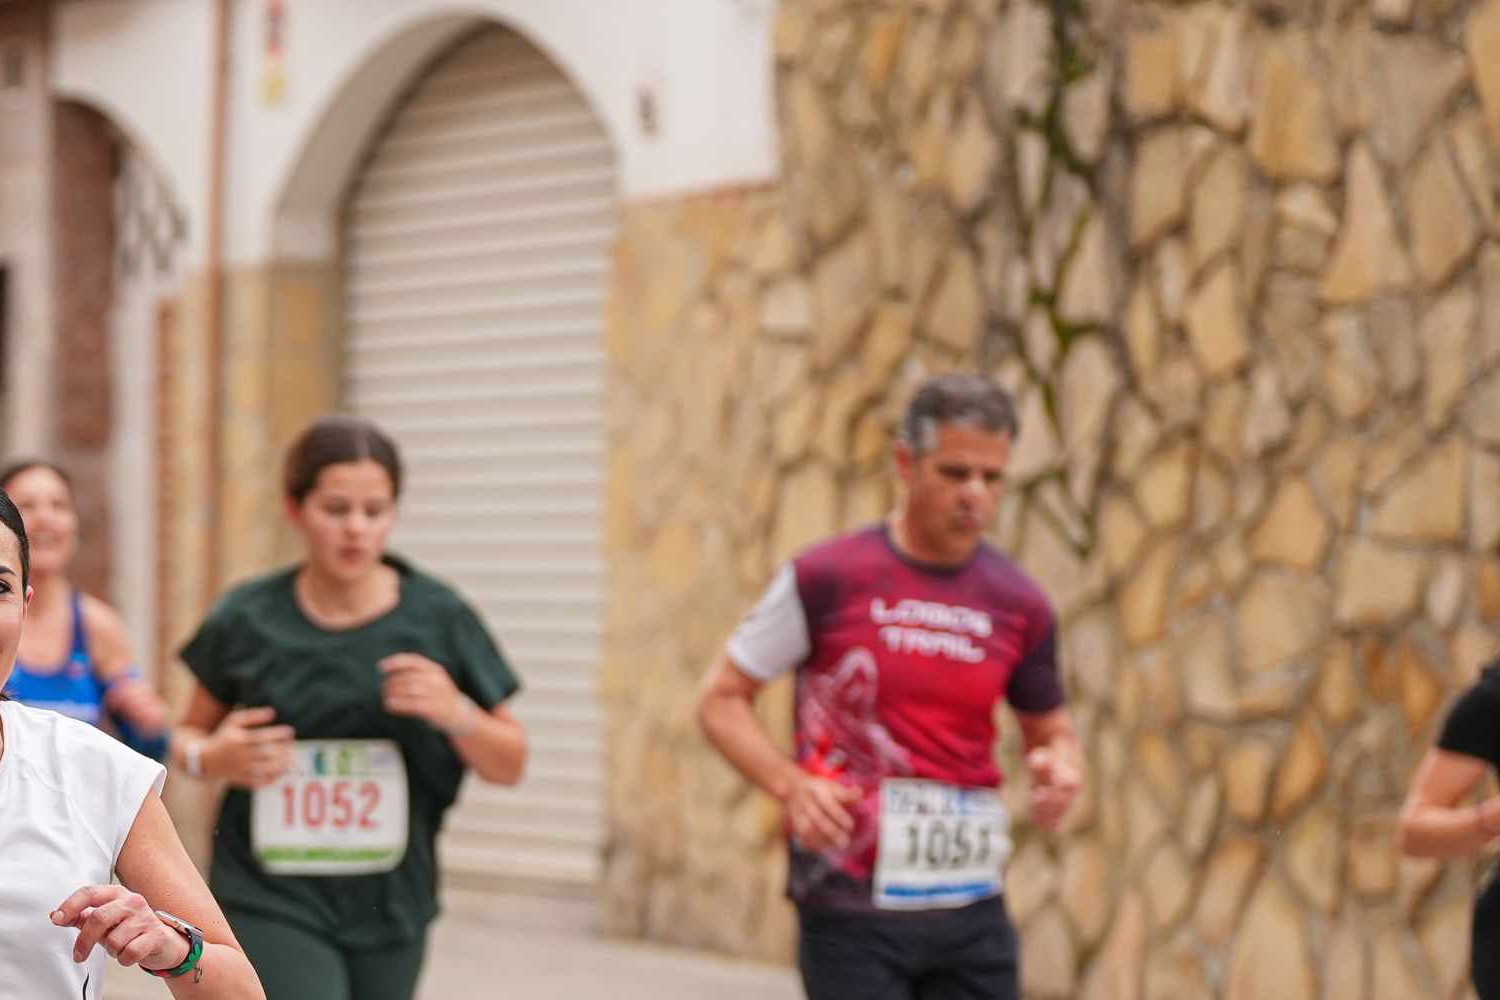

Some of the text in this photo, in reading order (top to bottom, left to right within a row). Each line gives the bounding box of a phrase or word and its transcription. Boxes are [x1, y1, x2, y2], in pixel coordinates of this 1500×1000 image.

[870, 597, 992, 638] LOBOS
[879, 626, 986, 663] TRAIL
[282, 781, 381, 829] 1052
